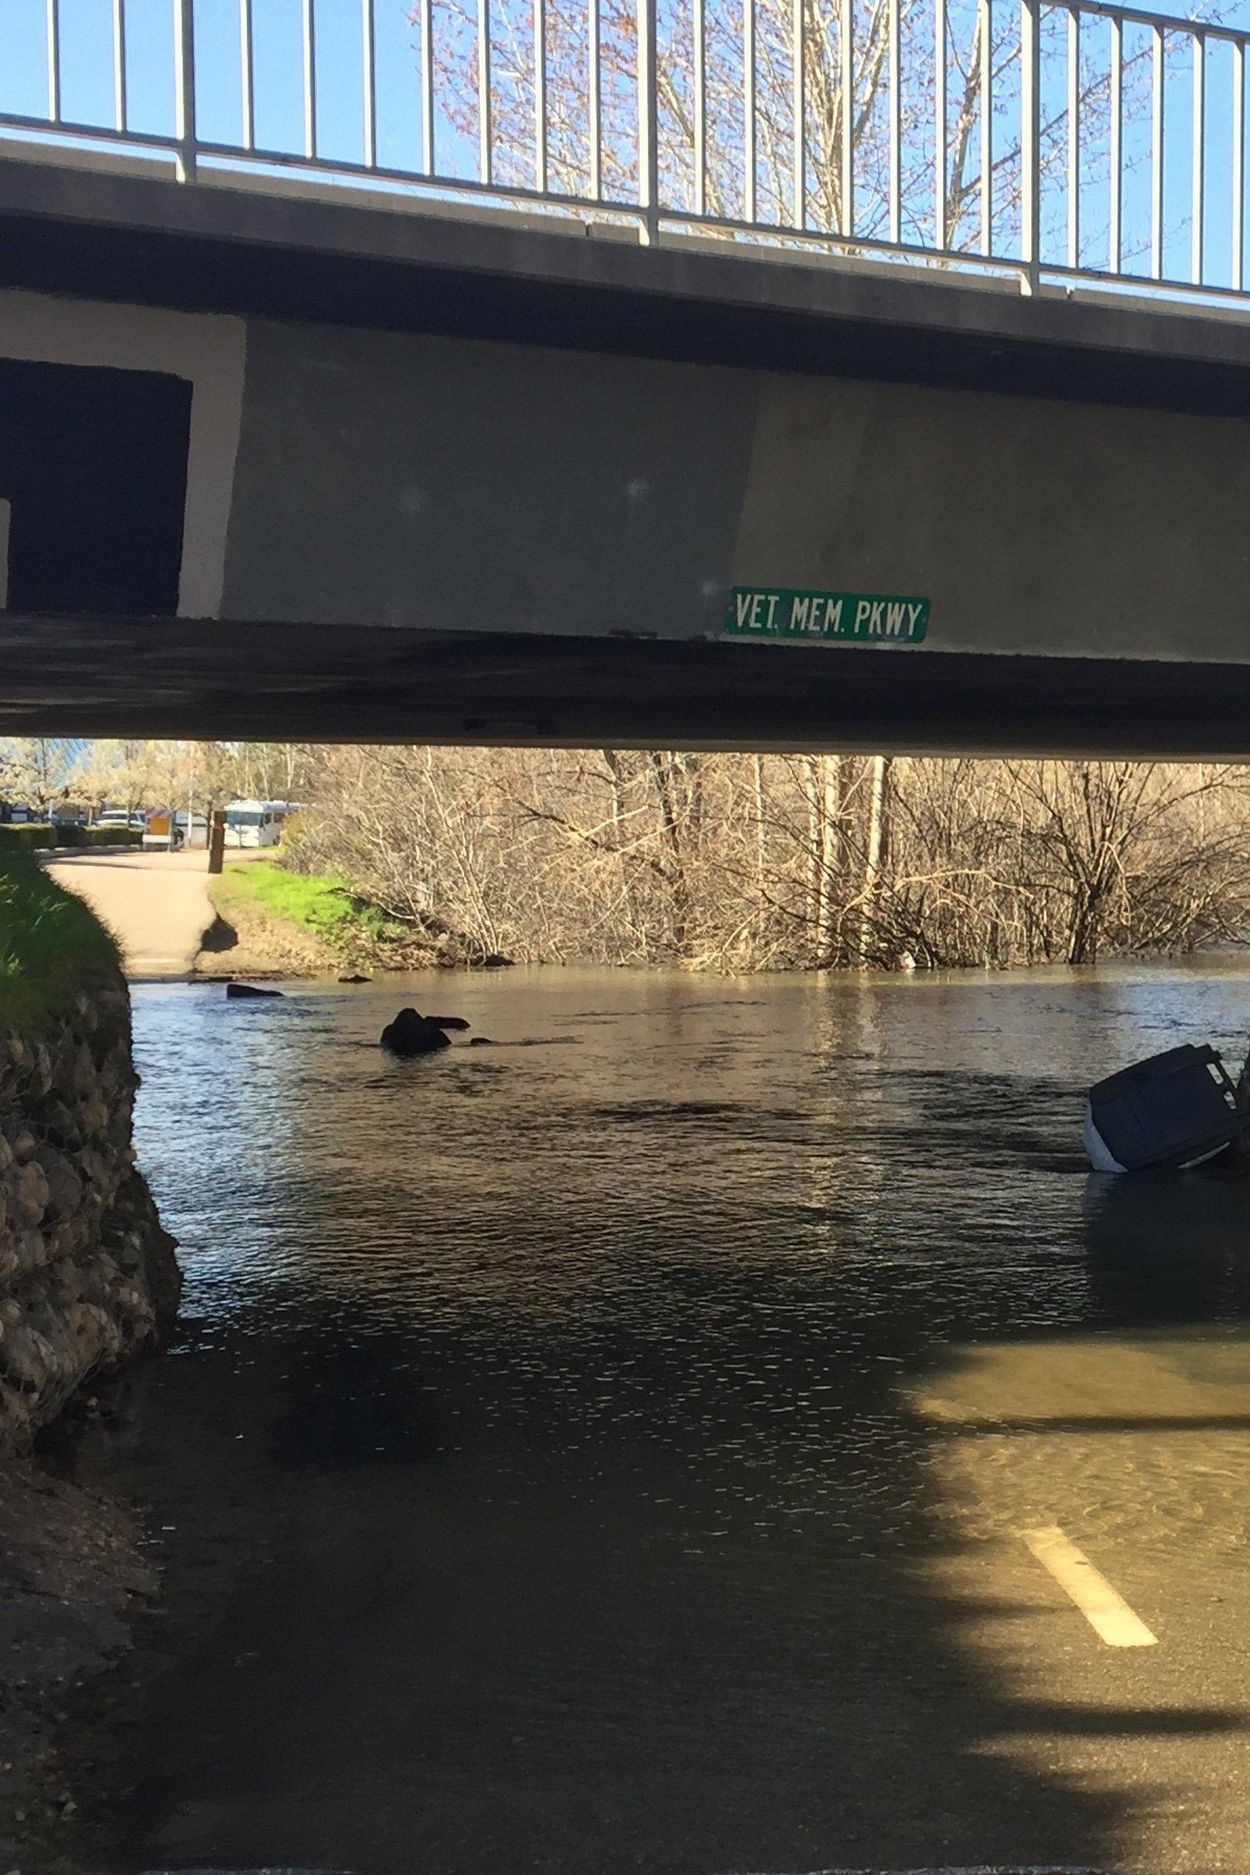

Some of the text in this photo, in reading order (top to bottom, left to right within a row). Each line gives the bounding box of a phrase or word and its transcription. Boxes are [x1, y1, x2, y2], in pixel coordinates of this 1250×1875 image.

[736, 593, 923, 636] VET. MEM. PKWY
